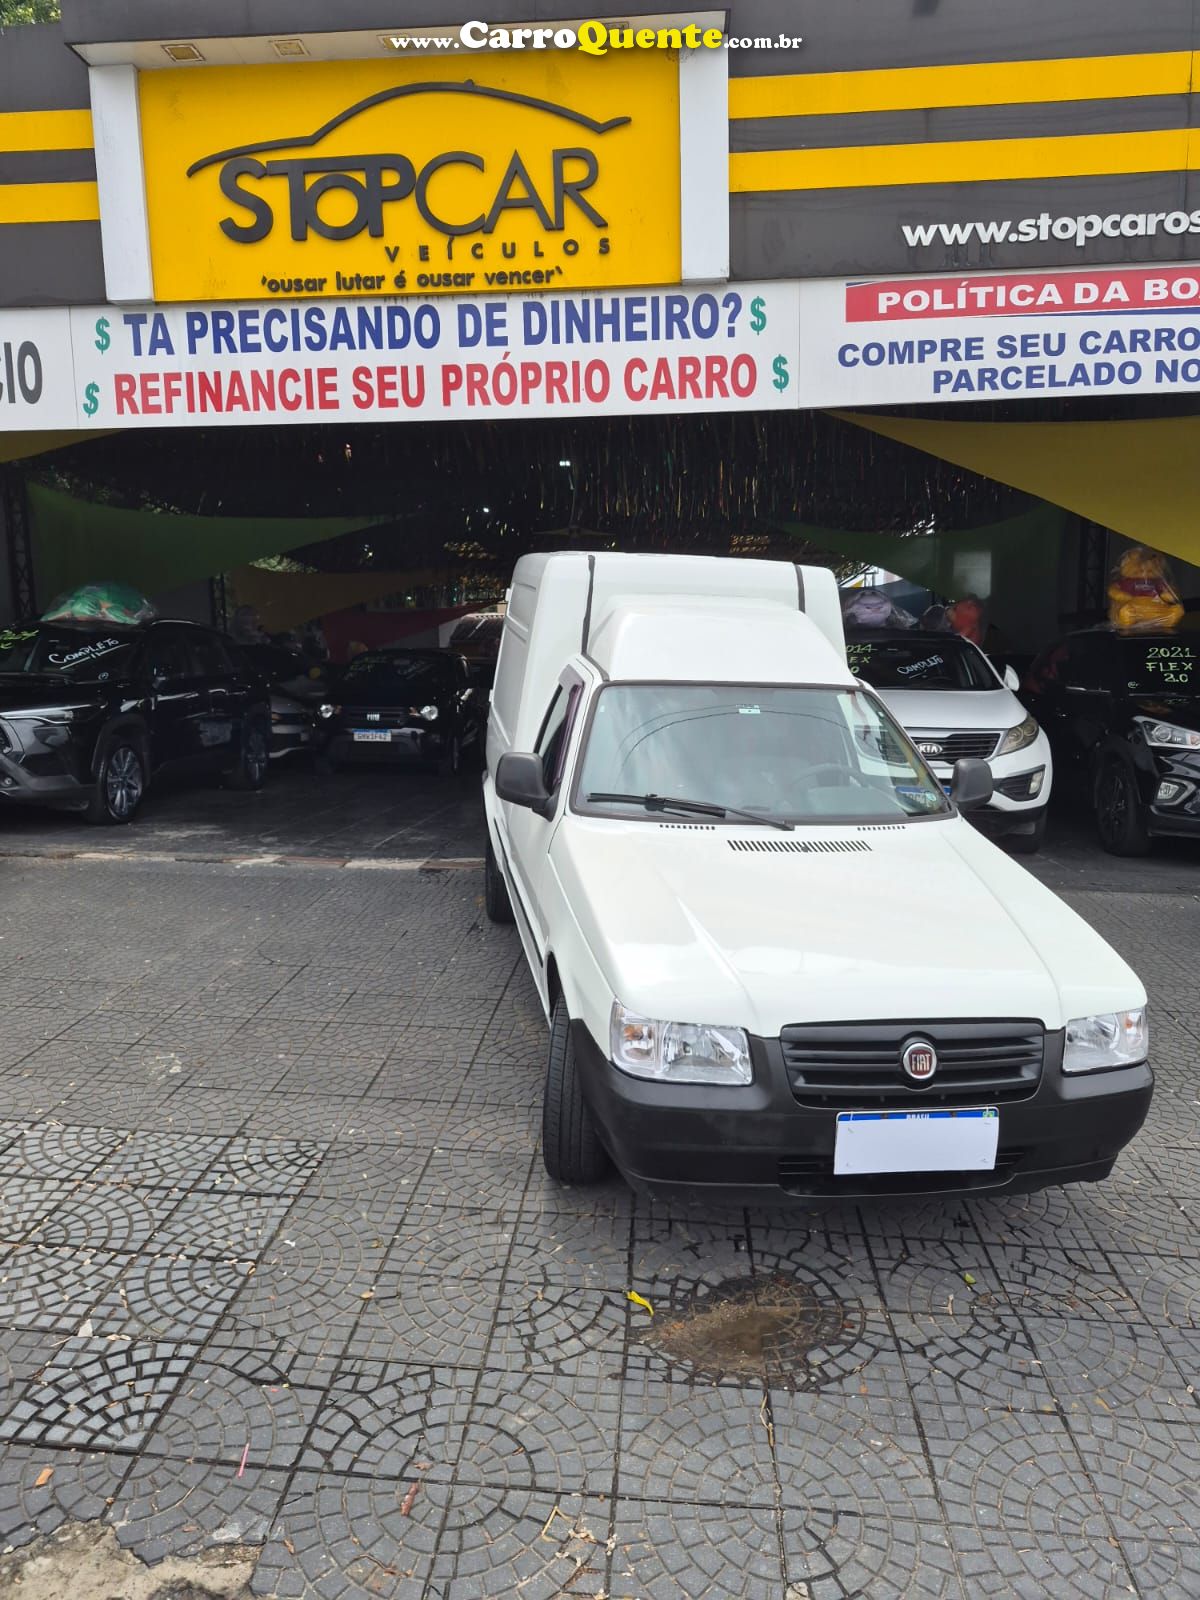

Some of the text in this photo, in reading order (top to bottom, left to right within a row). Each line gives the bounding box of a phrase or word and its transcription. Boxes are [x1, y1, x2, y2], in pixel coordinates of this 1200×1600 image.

[219, 148, 608, 243] STOPCAR
[384, 235, 611, 263] VEÍCULOS
[336, 271, 385, 290] lutar
[394, 270, 406, 289] é
[416, 272, 475, 287] ousar
[878, 281, 1064, 314] POLÍTICA
[1074, 280, 1130, 304] DA
[123, 313, 175, 356] TA
[186, 304, 441, 355] PRECISANDO
[457, 302, 509, 348] DE
[523, 292, 742, 346] DINHEIRO?
[838, 327, 1200, 368] COMPRE SEU CARRO
[0, 340, 43, 405] IO
[114, 367, 340, 415] REFINANCIE
[352, 365, 426, 410] SEU
[441, 351, 611, 406] PRÓPRIO
[623, 353, 757, 402] CARRO
[933, 358, 1200, 394] PARCELADO NO
[1145, 661, 1193, 672] FLEX
[1146, 646, 1197, 659] 2021
[1163, 672, 1189, 683] 2.0
[919, 744, 939, 753] KIA
[911, 1053, 931, 1072] FIAT
